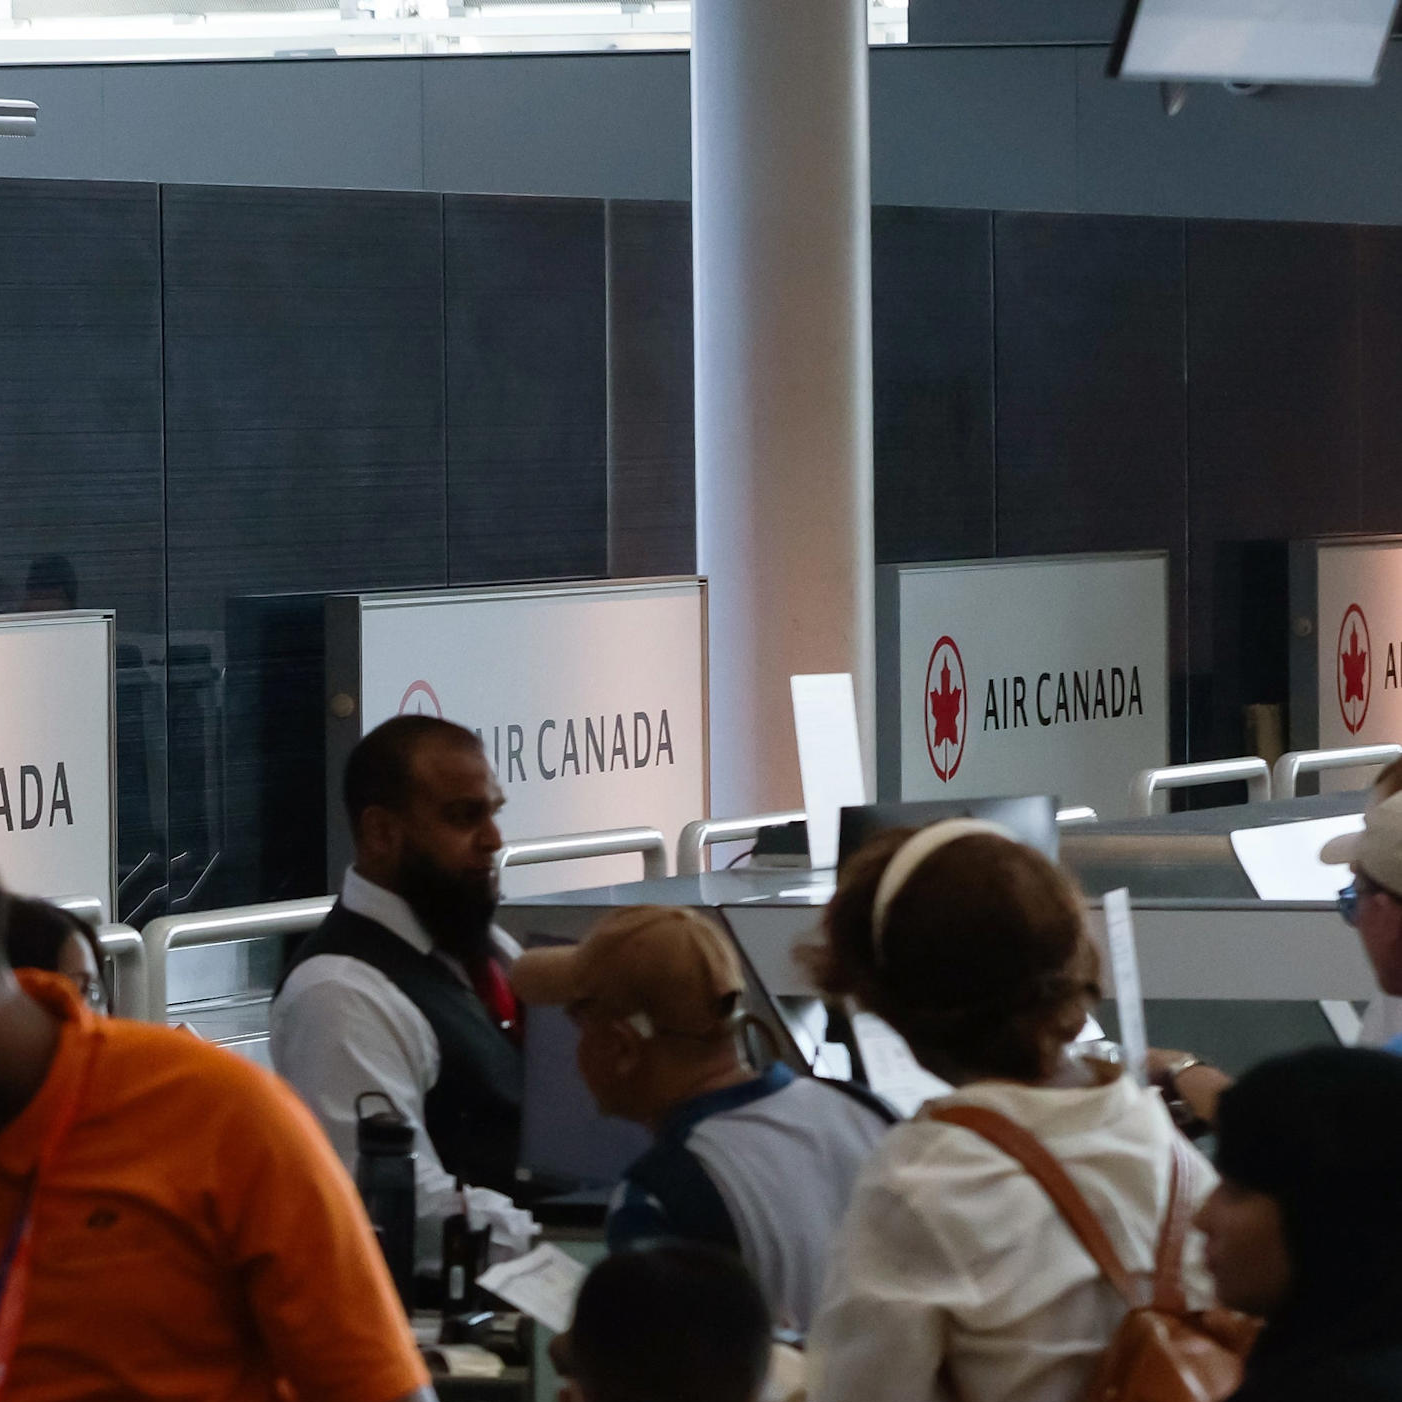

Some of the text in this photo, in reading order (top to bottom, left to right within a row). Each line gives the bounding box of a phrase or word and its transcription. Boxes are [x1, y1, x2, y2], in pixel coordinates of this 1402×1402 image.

[984, 665, 1144, 731] AIR CANADA
[475, 709, 675, 783] IR CANADA
